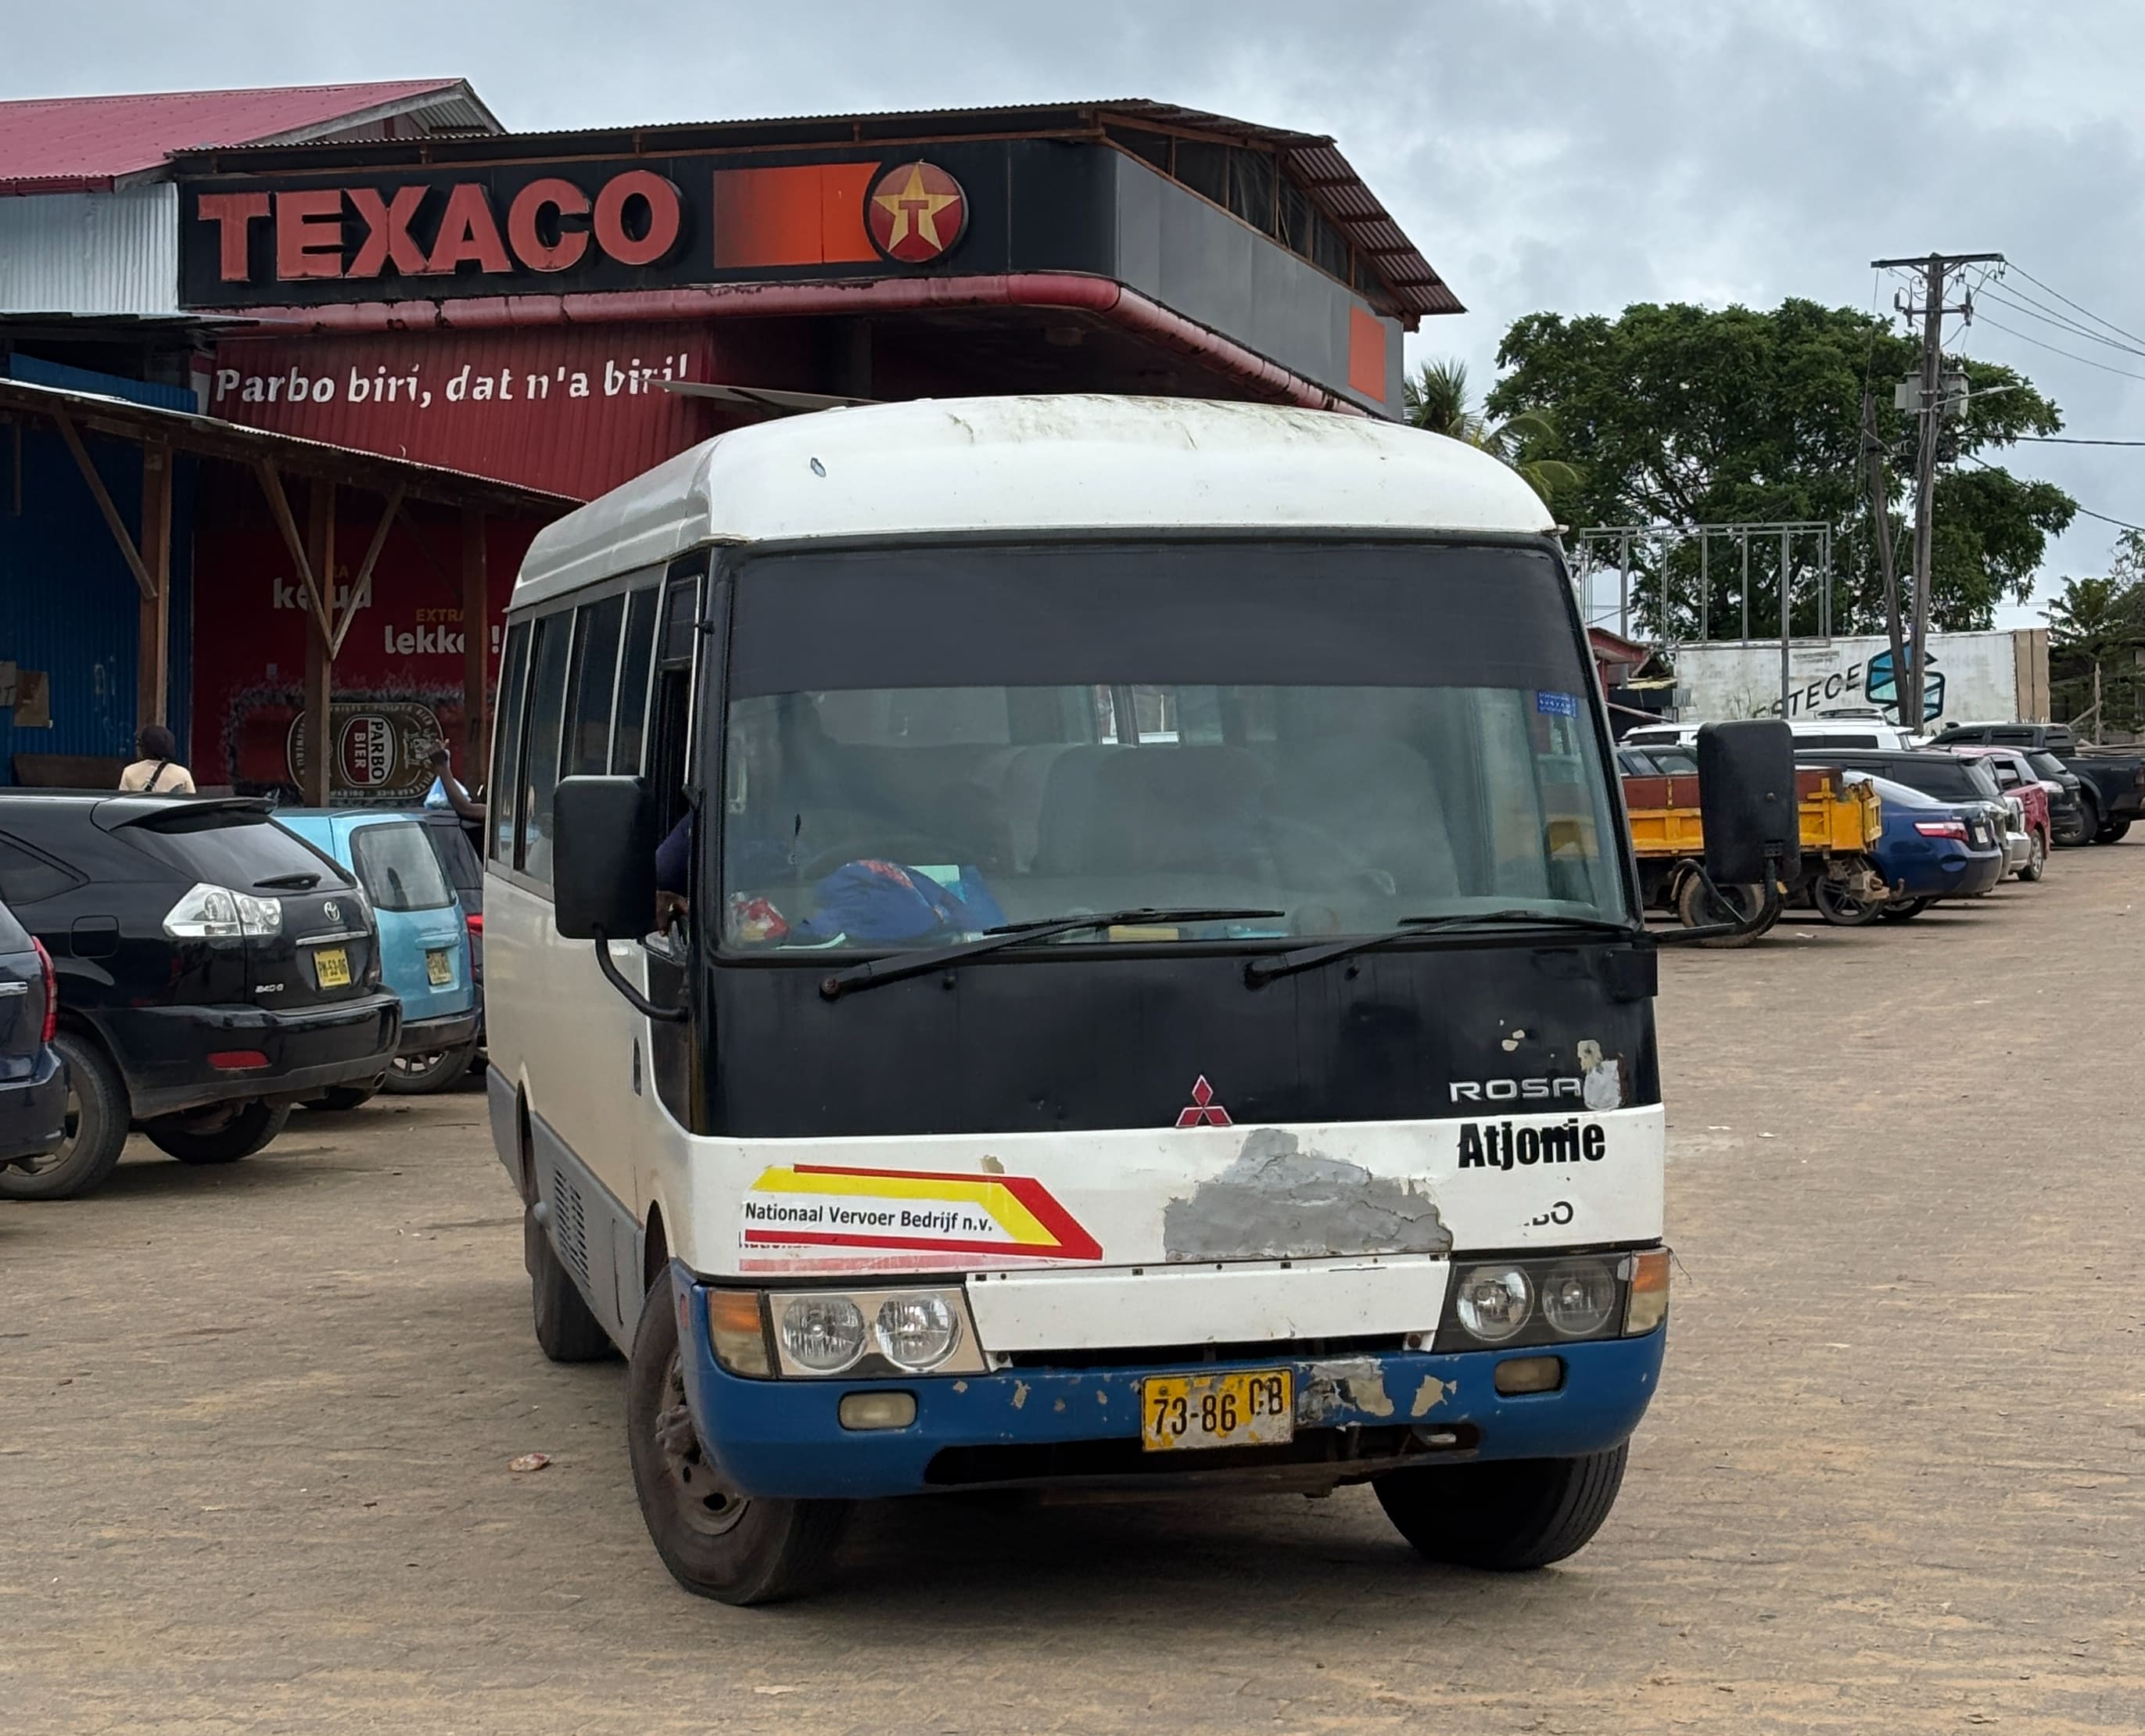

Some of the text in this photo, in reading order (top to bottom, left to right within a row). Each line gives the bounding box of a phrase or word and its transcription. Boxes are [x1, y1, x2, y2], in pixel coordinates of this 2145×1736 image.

[197, 169, 682, 282] TEXACO
[215, 366, 335, 404] Parbo
[348, 362, 432, 408] biri,
[446, 364, 511, 402] dat
[384, 624, 500, 655] lekk!
[353, 731, 367, 769] BIER
[371, 721, 386, 779] PARBO
[1449, 1077, 1582, 1103] ROSA
[744, 1202, 993, 1232] Nationaal Vervoer Bedrijf n.v.
[1153, 1393, 1237, 1436] 73-86
